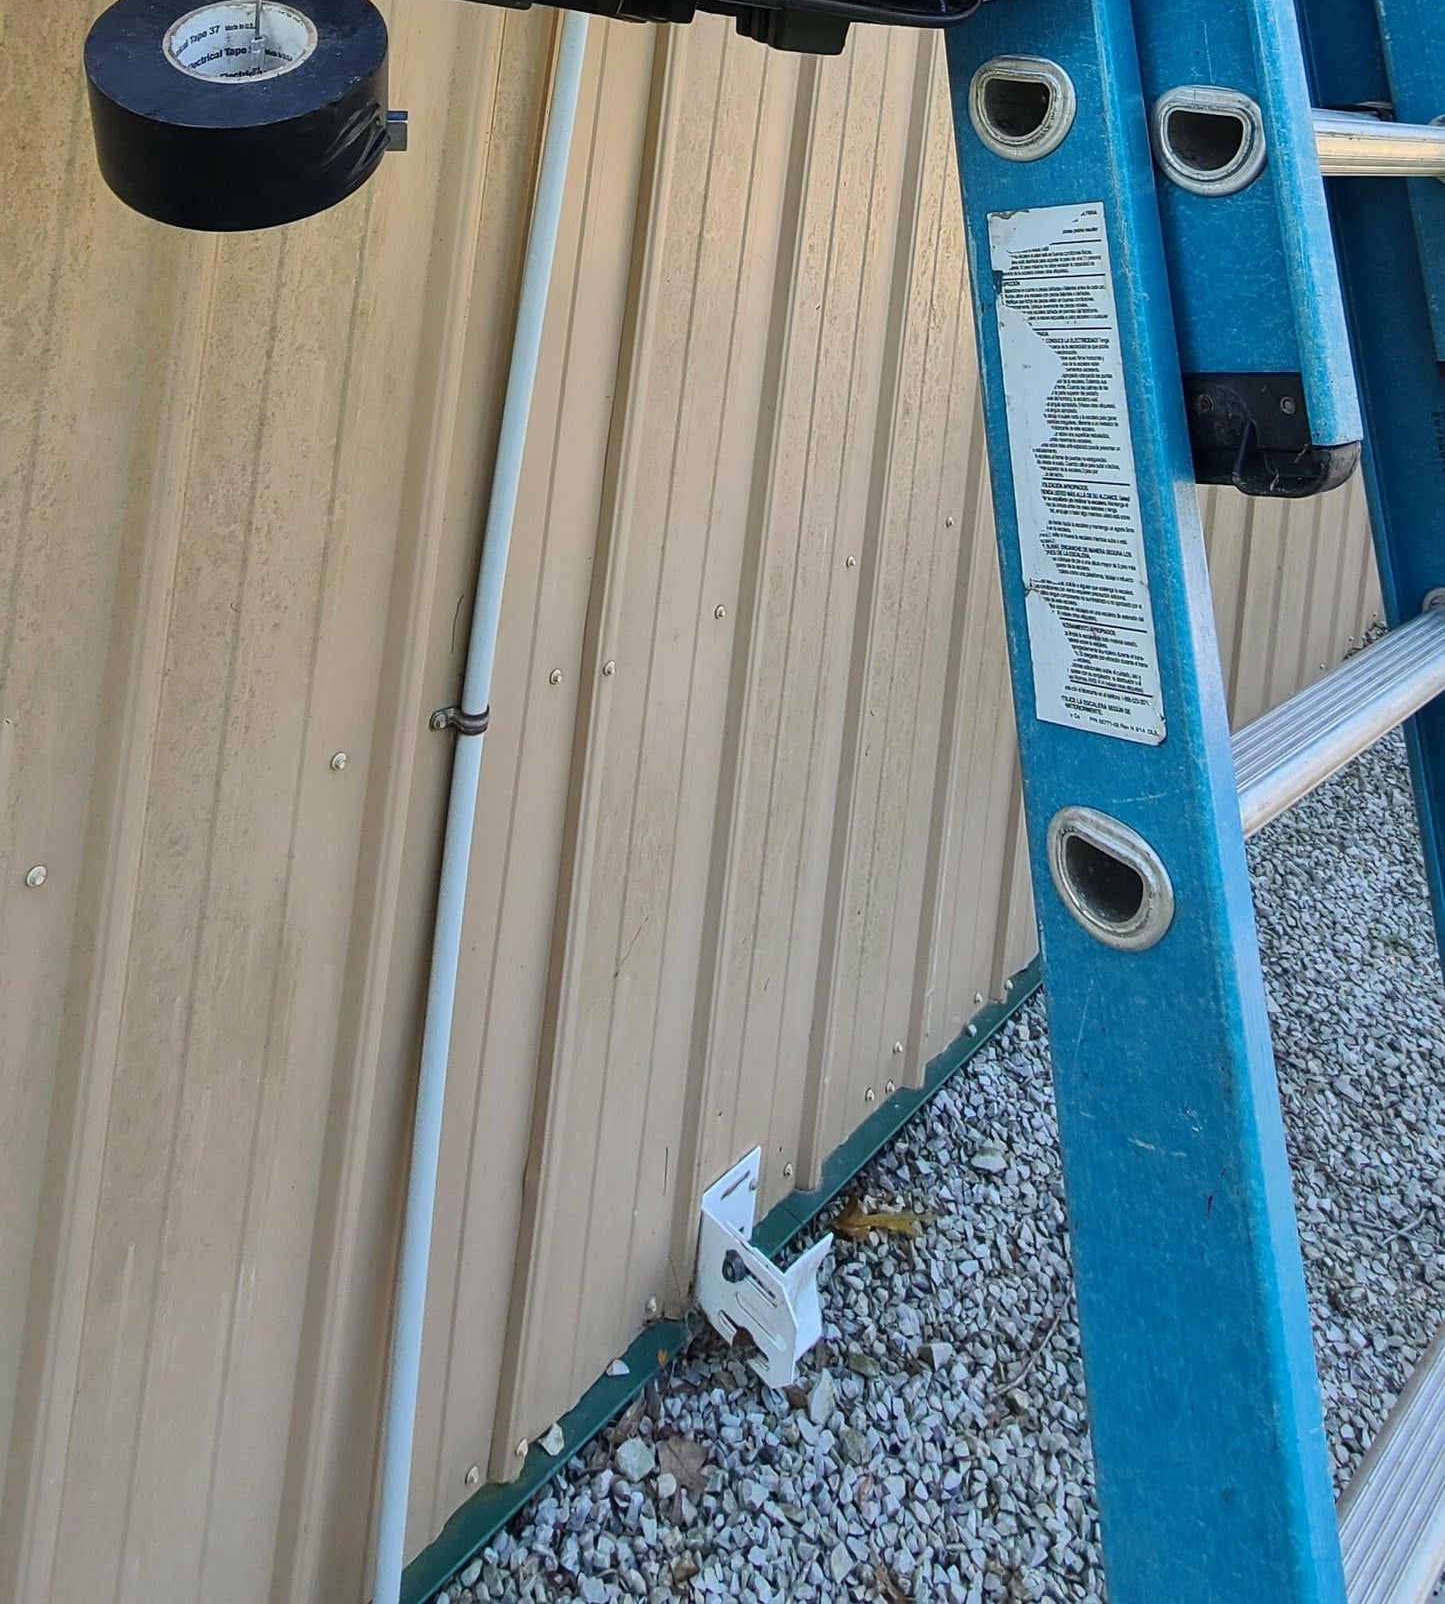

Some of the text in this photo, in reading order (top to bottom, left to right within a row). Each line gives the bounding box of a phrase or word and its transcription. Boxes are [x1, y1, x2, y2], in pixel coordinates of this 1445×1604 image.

[190, 31, 207, 44] Tape
[209, 25, 220, 35] 37
[188, 49, 223, 69] ectrical
[224, 47, 247, 56] Tape
